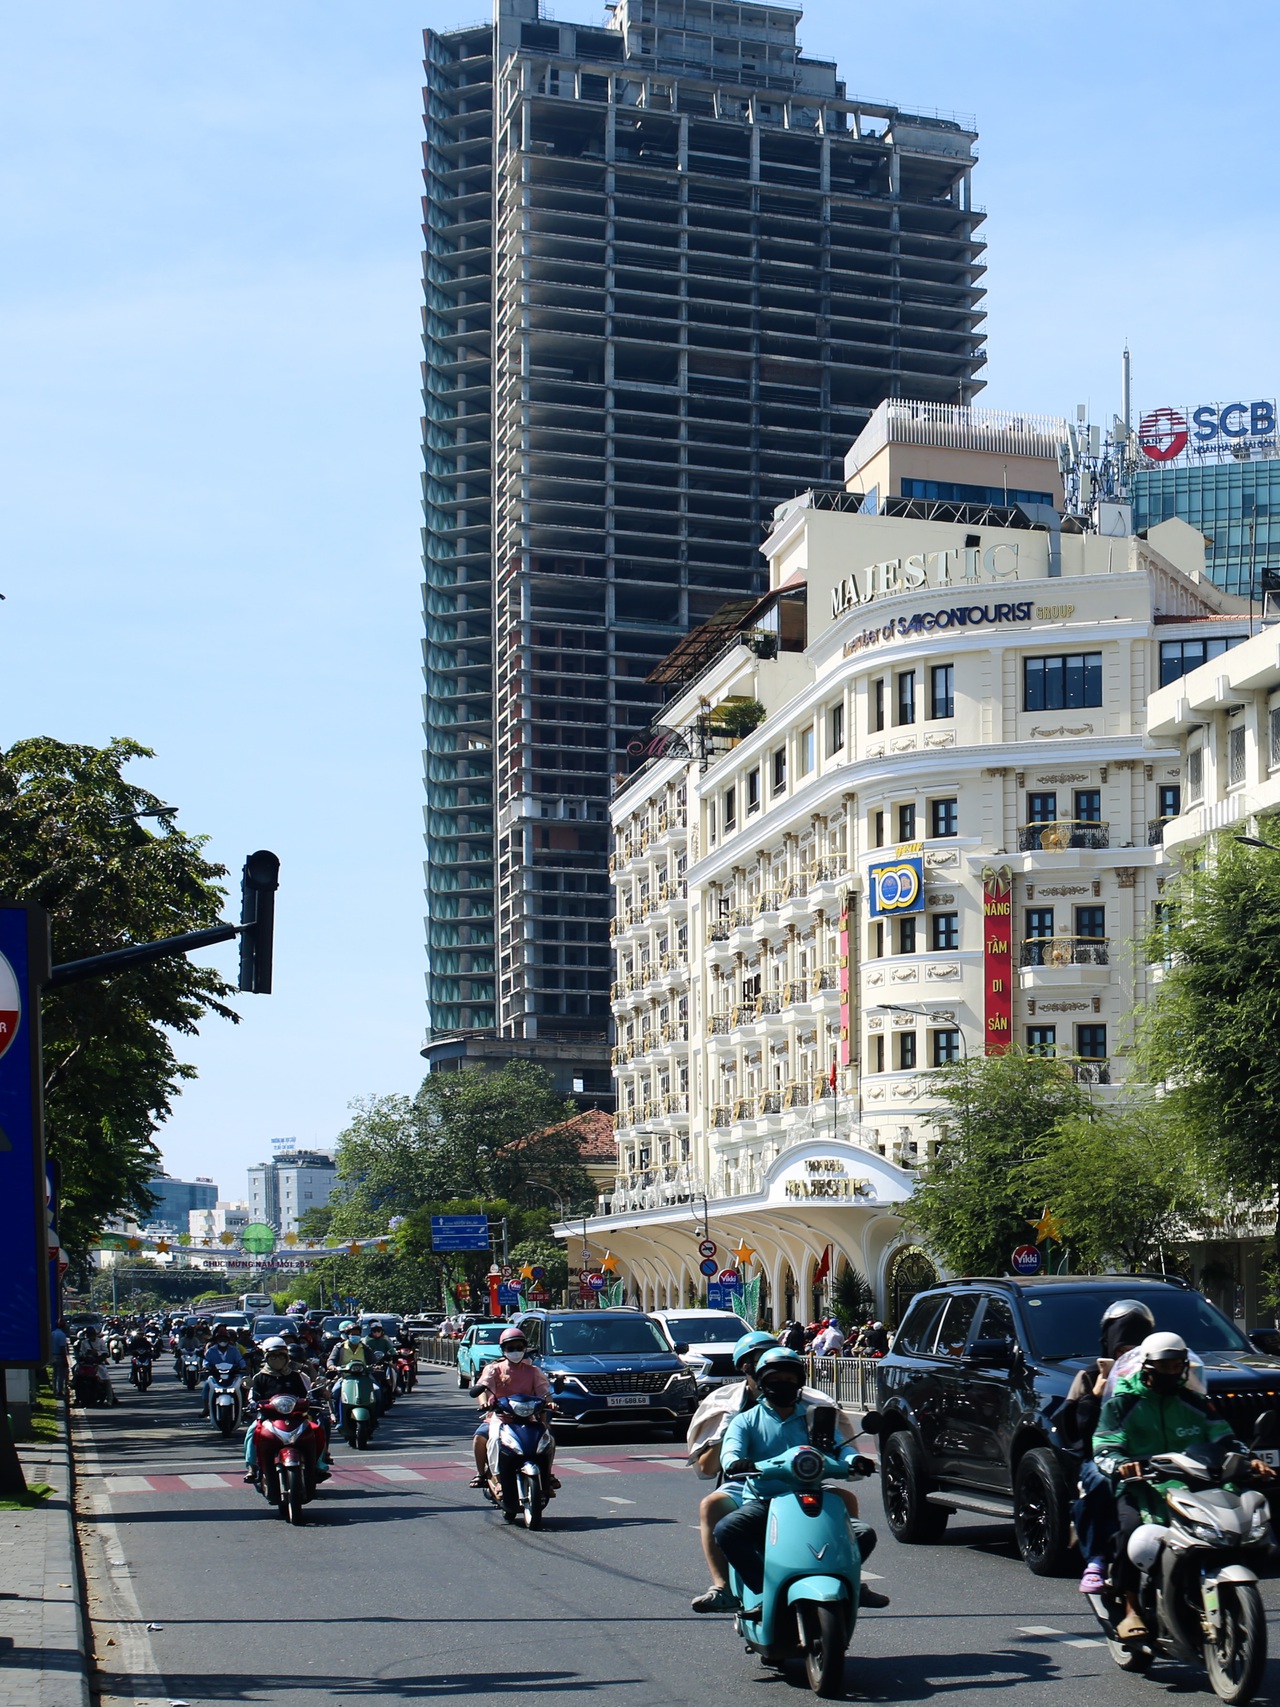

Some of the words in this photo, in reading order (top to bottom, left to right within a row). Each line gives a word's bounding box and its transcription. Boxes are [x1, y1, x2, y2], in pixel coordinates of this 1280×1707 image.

[1193, 401, 1276, 441] SCB
[830, 543, 1019, 620] MAJESTIC
[882, 618, 896, 640] of
[897, 601, 1034, 636] SAIGONTOURIST
[1036, 604, 1075, 620] GROUP
[870, 864, 919, 912] 100
[984, 900, 1010, 916] NÂNG
[987, 935, 1008, 954] TẦM
[992, 979, 1003, 993] DI
[988, 1012, 1008, 1031] SẢN
[804, 1160, 843, 1172] HOTEL
[785, 1178, 870, 1197] MAJESTIC
[1015, 1250, 1037, 1264] Vikki
[1175, 1427, 1200, 1438] Grab
